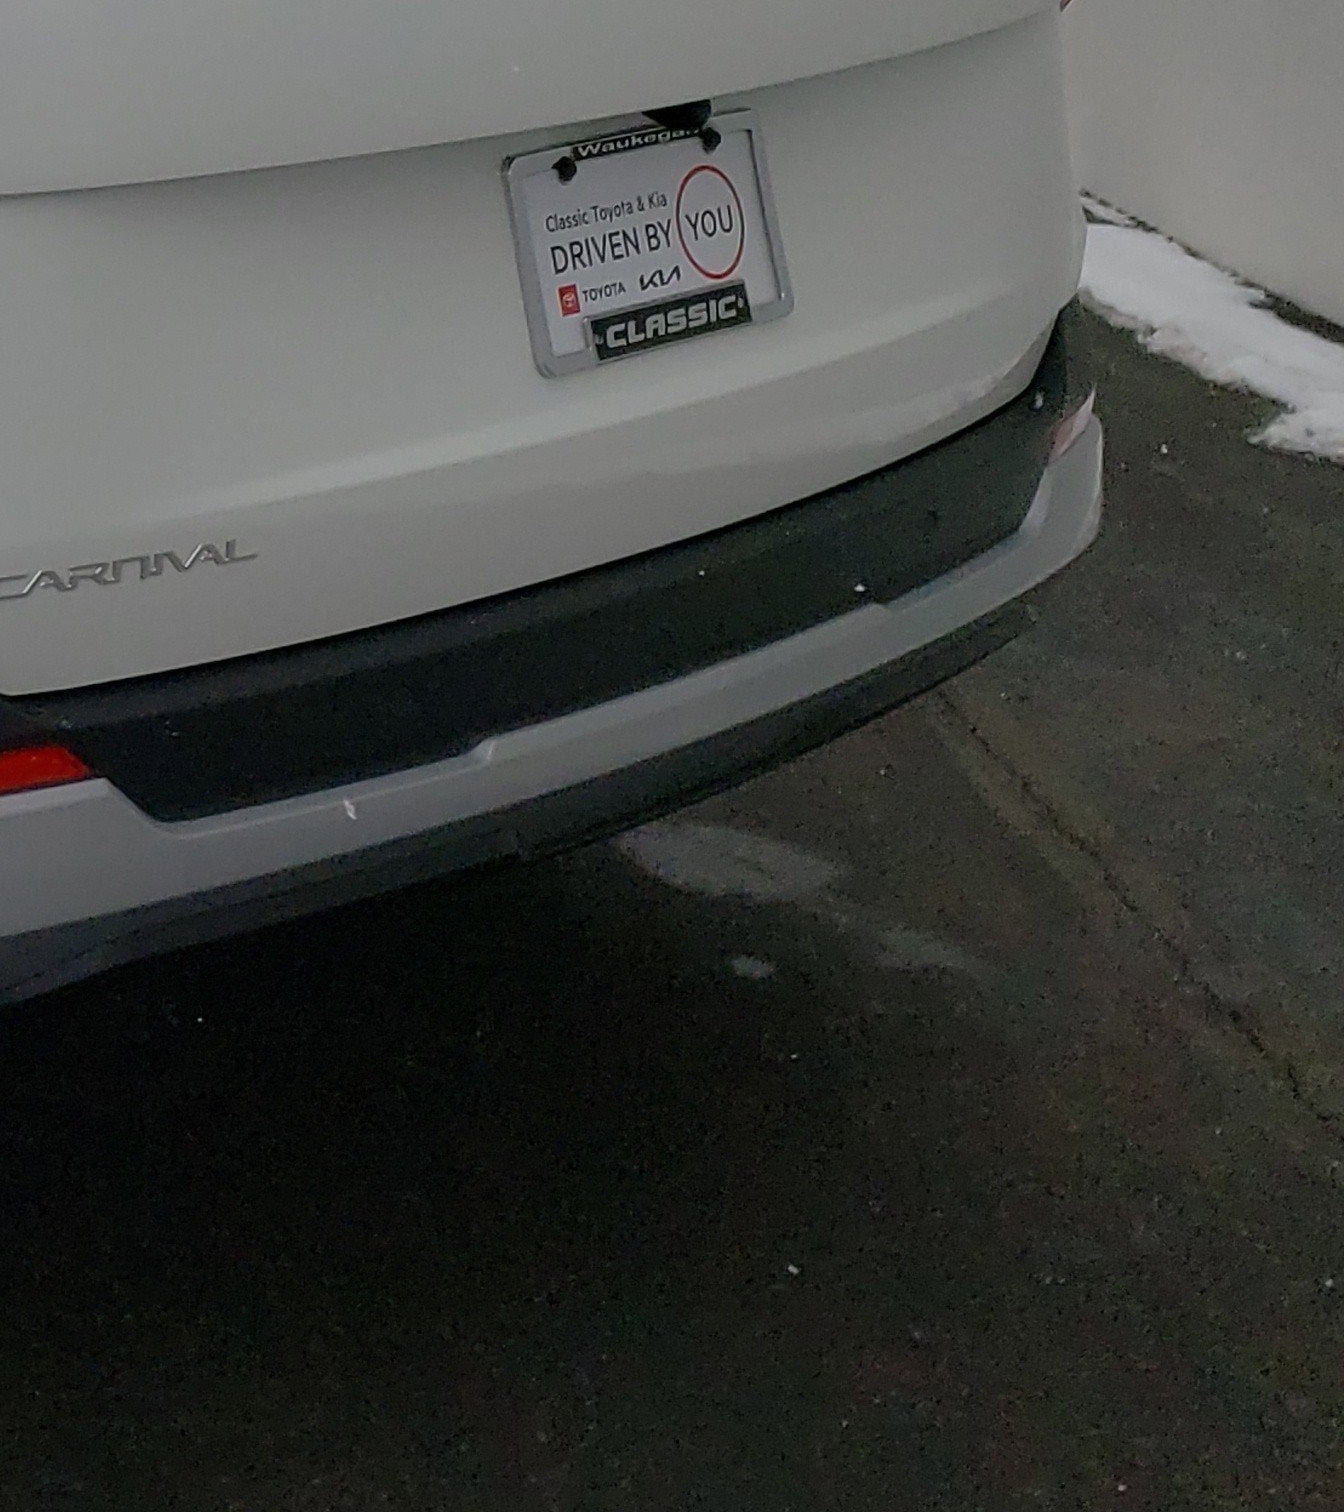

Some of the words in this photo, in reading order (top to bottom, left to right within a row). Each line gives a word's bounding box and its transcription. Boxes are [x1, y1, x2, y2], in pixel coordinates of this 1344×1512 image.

[545, 207, 589, 233] Classic
[593, 202, 634, 224] Toyota
[636, 195, 645, 211] &
[648, 191, 668, 209] Kia
[551, 226, 641, 275] DRIVEN
[645, 218, 673, 253] BY
[685, 204, 734, 241] YOU
[583, 282, 627, 304] TOYOTA
[639, 265, 682, 292] KIA
[606, 294, 737, 349] CLASSIC
